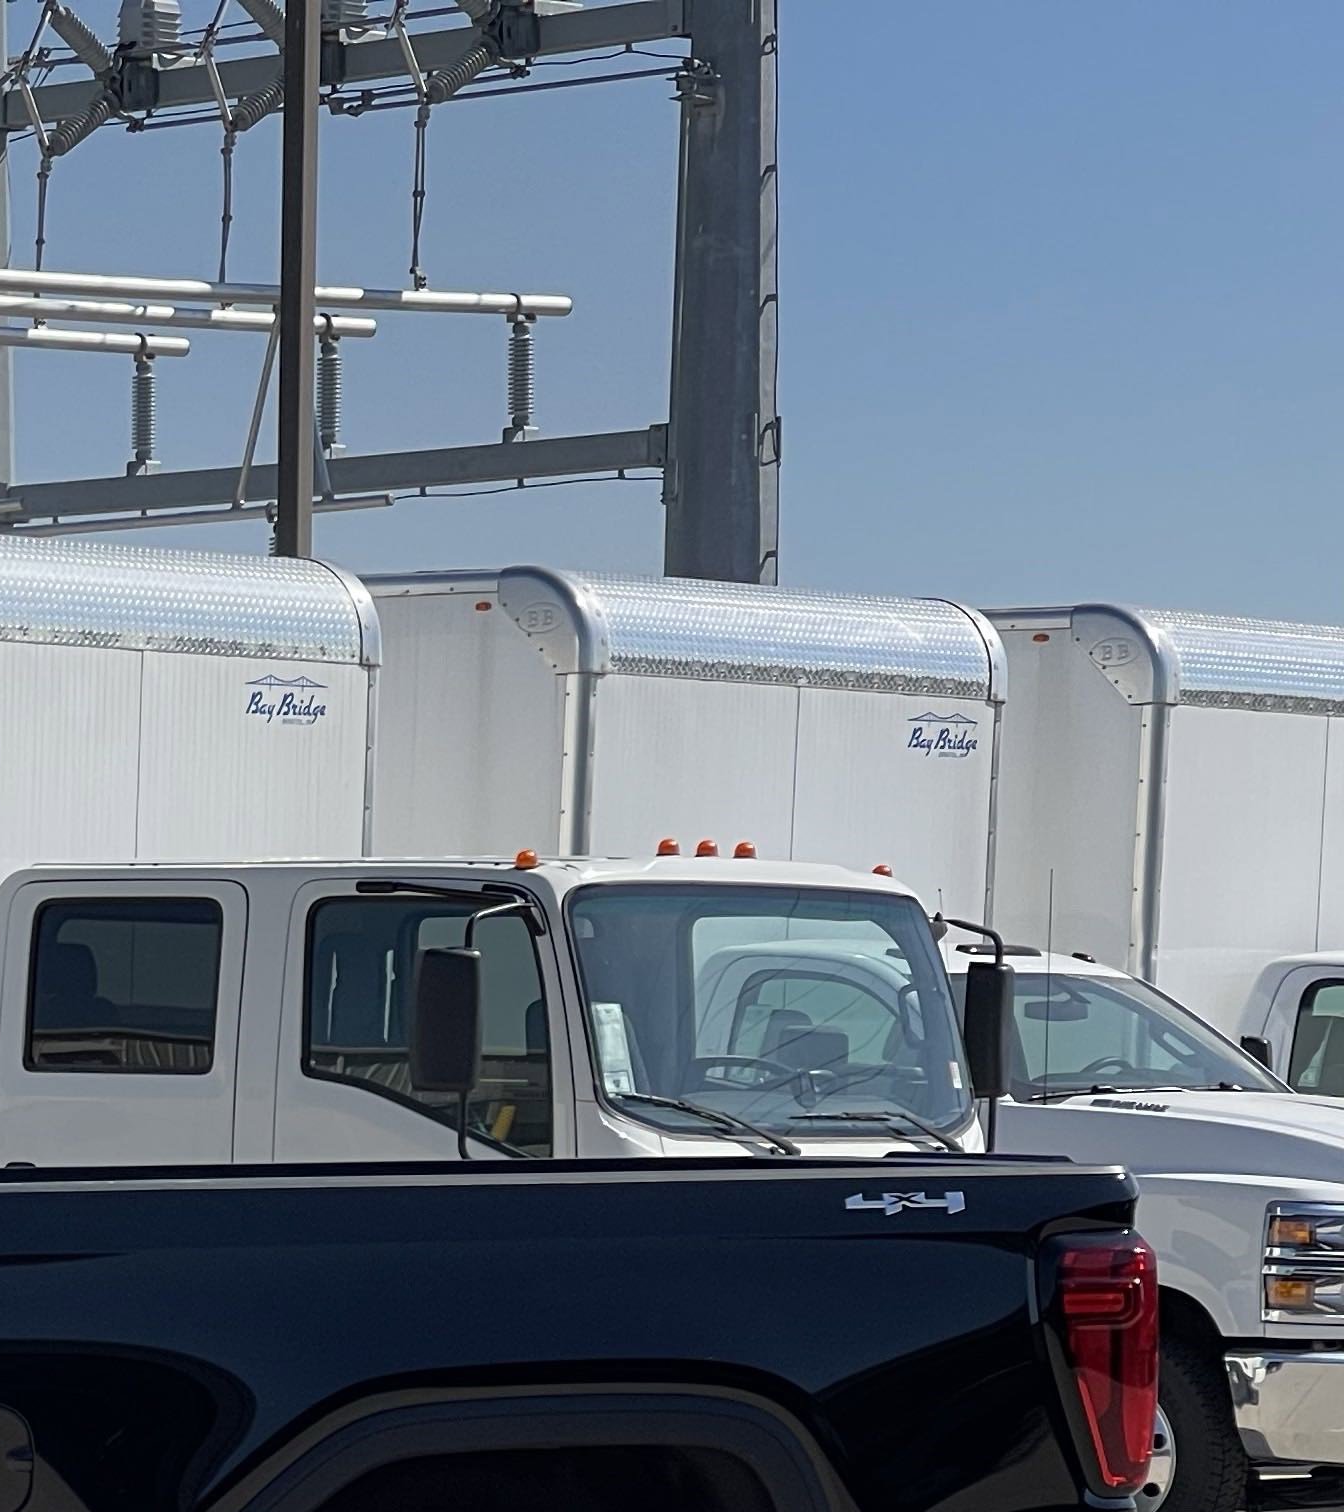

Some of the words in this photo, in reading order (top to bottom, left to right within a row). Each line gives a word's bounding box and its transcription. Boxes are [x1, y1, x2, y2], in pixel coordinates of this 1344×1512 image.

[245, 690, 276, 724] Bay
[276, 691, 327, 724] Bridge
[907, 726, 934, 757] Bay
[934, 727, 978, 758] Bridge
